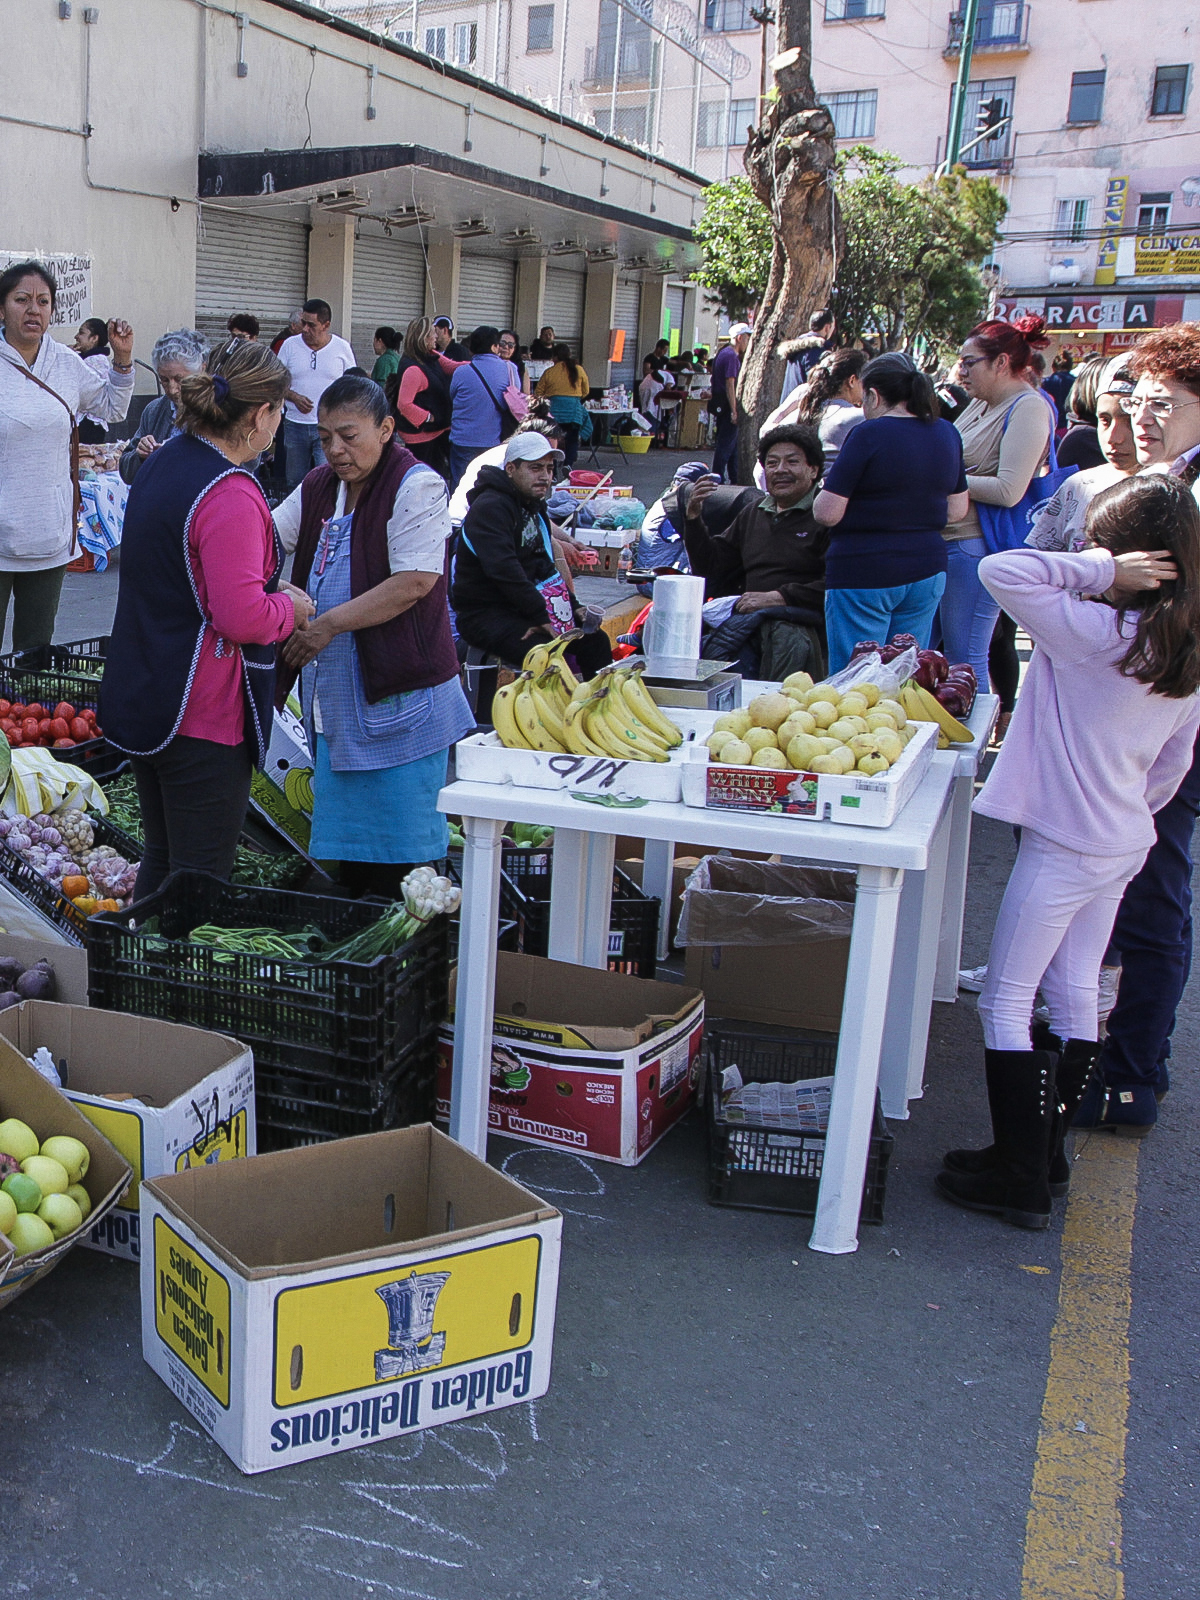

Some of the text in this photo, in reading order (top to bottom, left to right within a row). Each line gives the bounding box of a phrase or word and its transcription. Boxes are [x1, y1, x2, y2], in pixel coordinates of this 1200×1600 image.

[1099, 178, 1125, 268] DENTAL
[709, 772, 777, 790] WHITE
[709, 786, 779, 804] BUNNY
[507, 1116, 588, 1148] PREMIUM
[169, 1245, 209, 1308] Apples
[165, 1273, 215, 1350] Delicious
[172, 1311, 209, 1375] Golden
[270, 1349, 533, 1454] Golden Delicious
